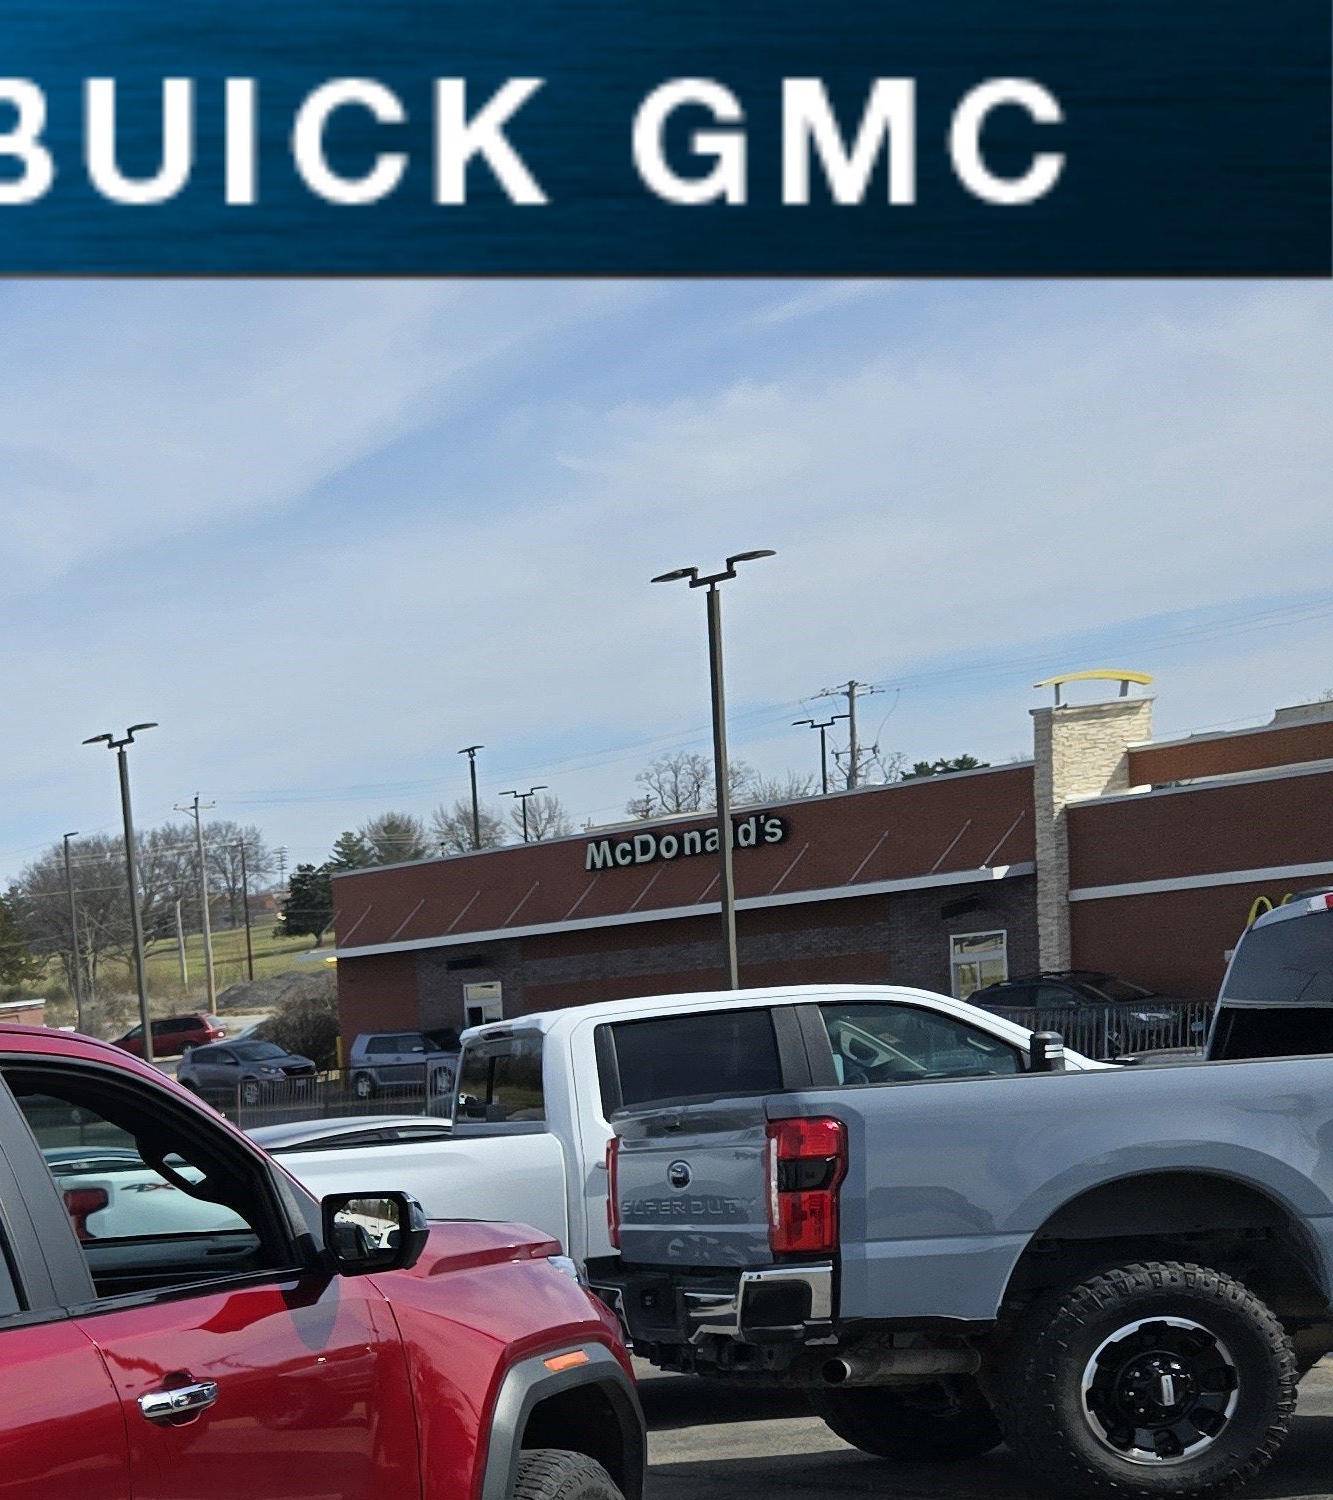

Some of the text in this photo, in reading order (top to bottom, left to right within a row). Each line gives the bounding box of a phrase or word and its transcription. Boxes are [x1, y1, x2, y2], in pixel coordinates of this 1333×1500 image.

[585, 815, 783, 870] McDonad's
[621, 1199, 757, 1215] SUPER DUTY
